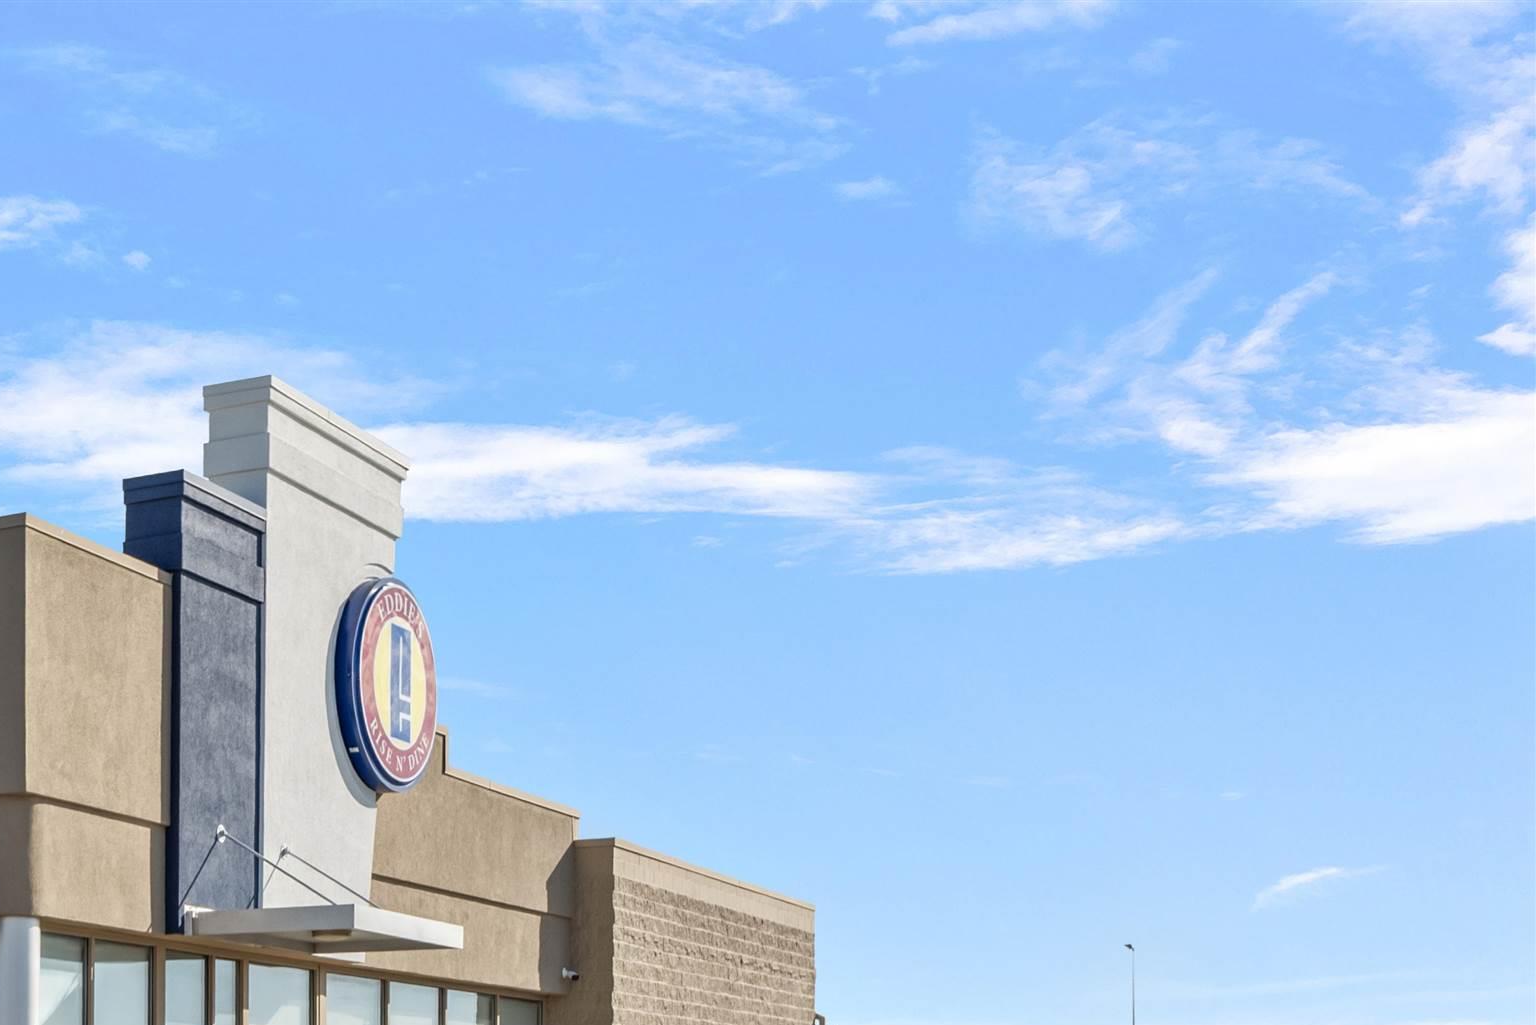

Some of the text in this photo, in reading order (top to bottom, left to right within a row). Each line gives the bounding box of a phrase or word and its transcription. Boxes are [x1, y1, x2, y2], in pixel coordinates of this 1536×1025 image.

[376, 591, 425, 639] EDDIE'S
[370, 717, 393, 765] RISE
[408, 732, 429, 772] DINE
